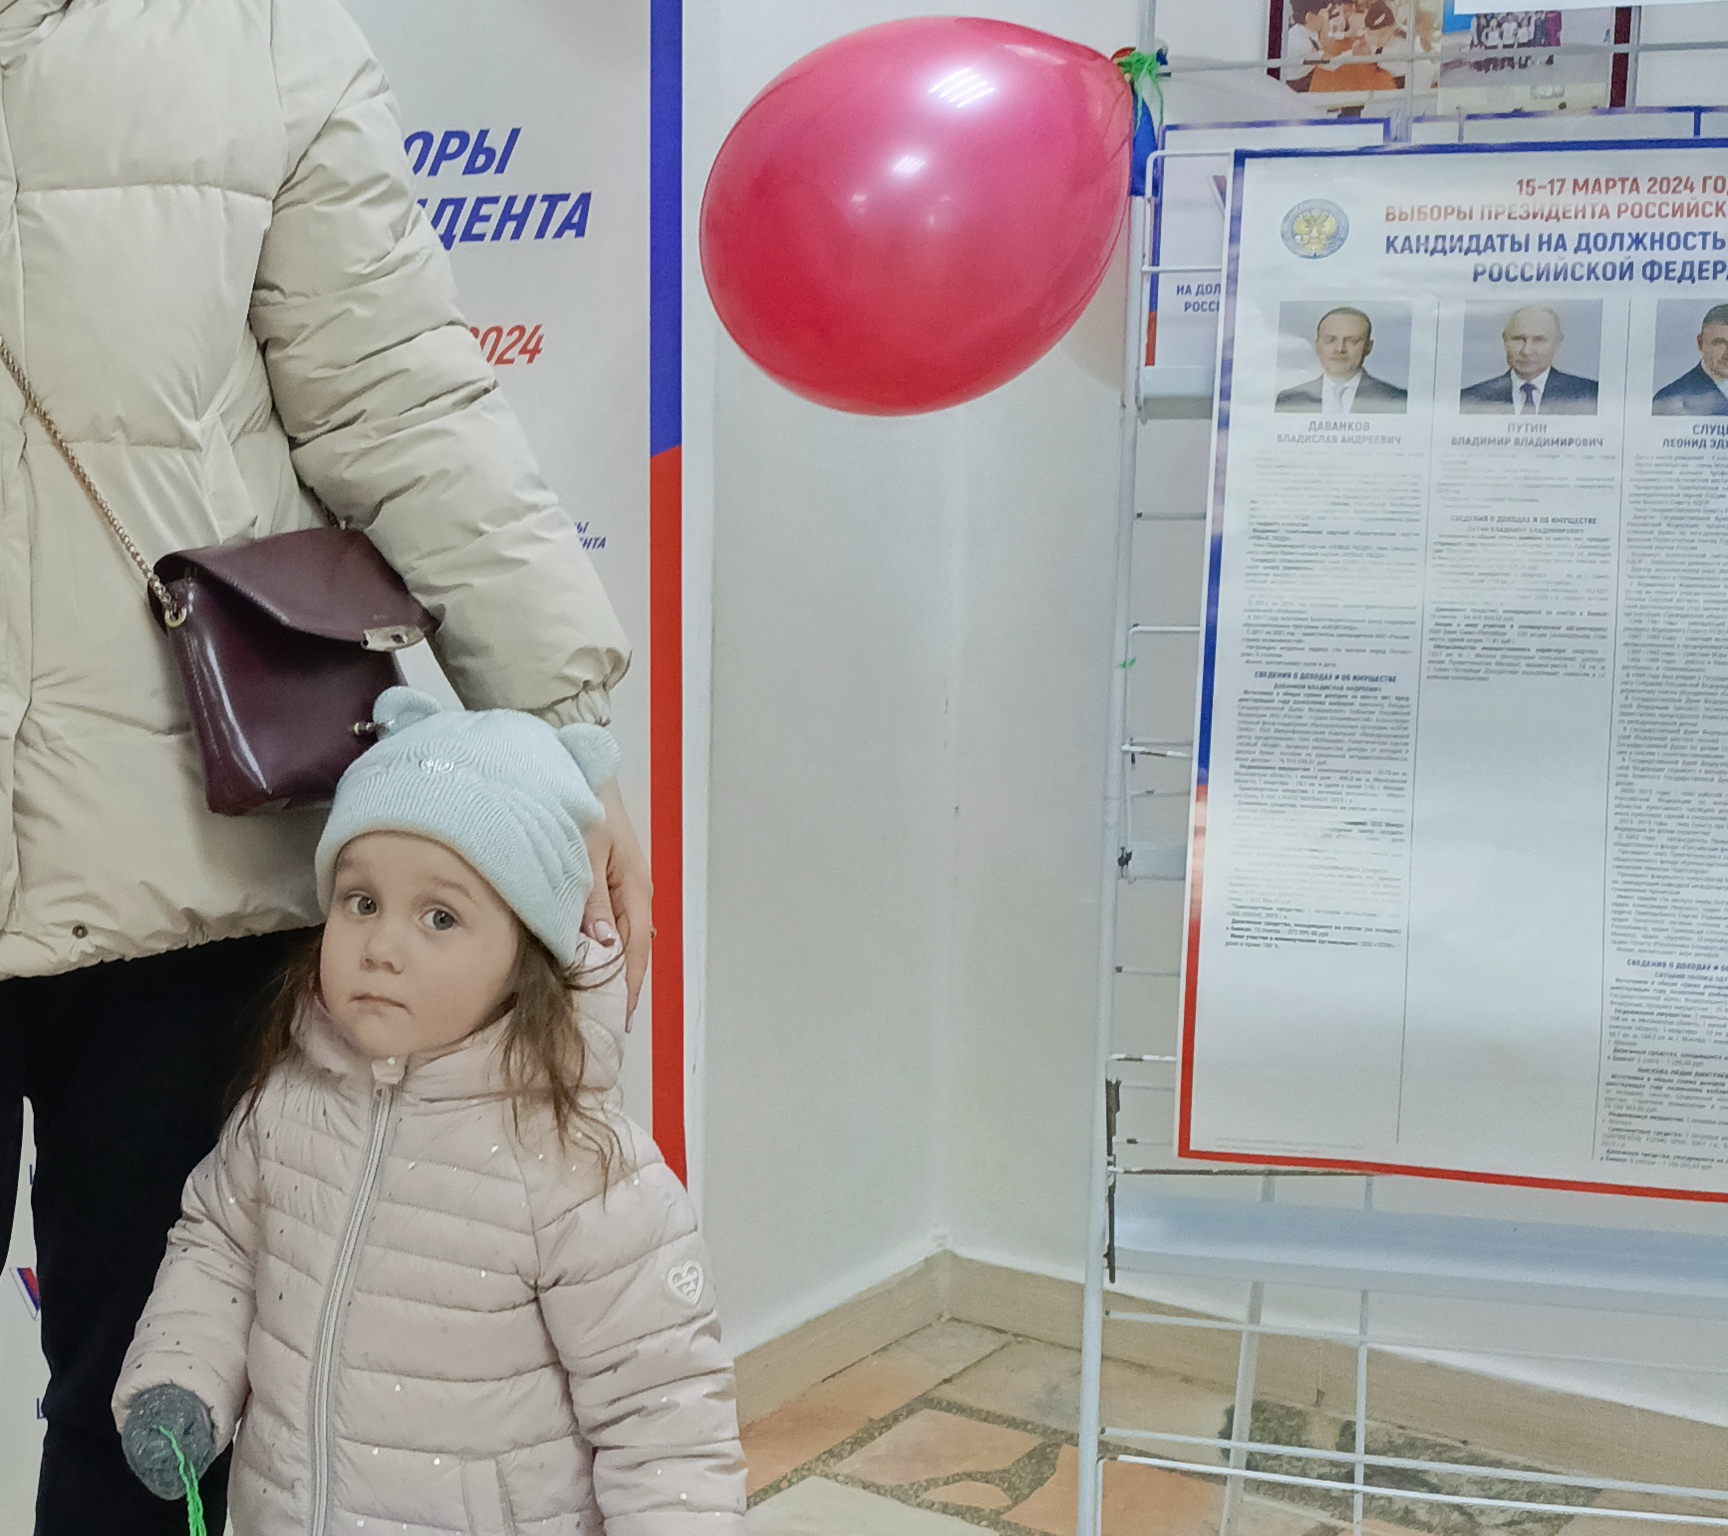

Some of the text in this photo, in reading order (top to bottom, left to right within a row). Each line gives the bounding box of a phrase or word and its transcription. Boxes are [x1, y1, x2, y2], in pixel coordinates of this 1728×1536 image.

[403, 127, 522, 177] ОРЫ
[1572, 177, 1640, 195] МАРТА
[1647, 175, 1695, 194] 2024
[1702, 175, 1728, 194] ГО
[1385, 204, 1473, 222] ВЫБОРЫ
[1480, 202, 1610, 222] ПРЕЗИДЕНТА
[1385, 230, 1726, 256] КАНДИДАТЫ НА ДОЛЖНОСТЬ
[1472, 255, 1728, 284] РОССИЙСКОЙ ФЕДЕР
[1176, 284, 1192, 296] НА
[469, 323, 544, 365] 024
[1308, 421, 1370, 432] ДАВАНКОВ
[1508, 422, 1547, 434] ПУТИН
[1693, 424, 1728, 437] СЛУЦ
[1277, 433, 1401, 445] ВЛАДИСЛАВ АНДРЕЕВИЧ
[1451, 437, 1603, 448] ВЛАДИМИР ВЛАДИМИРОВИЧ
[1662, 438, 1707, 449] ЛЕОНИД
